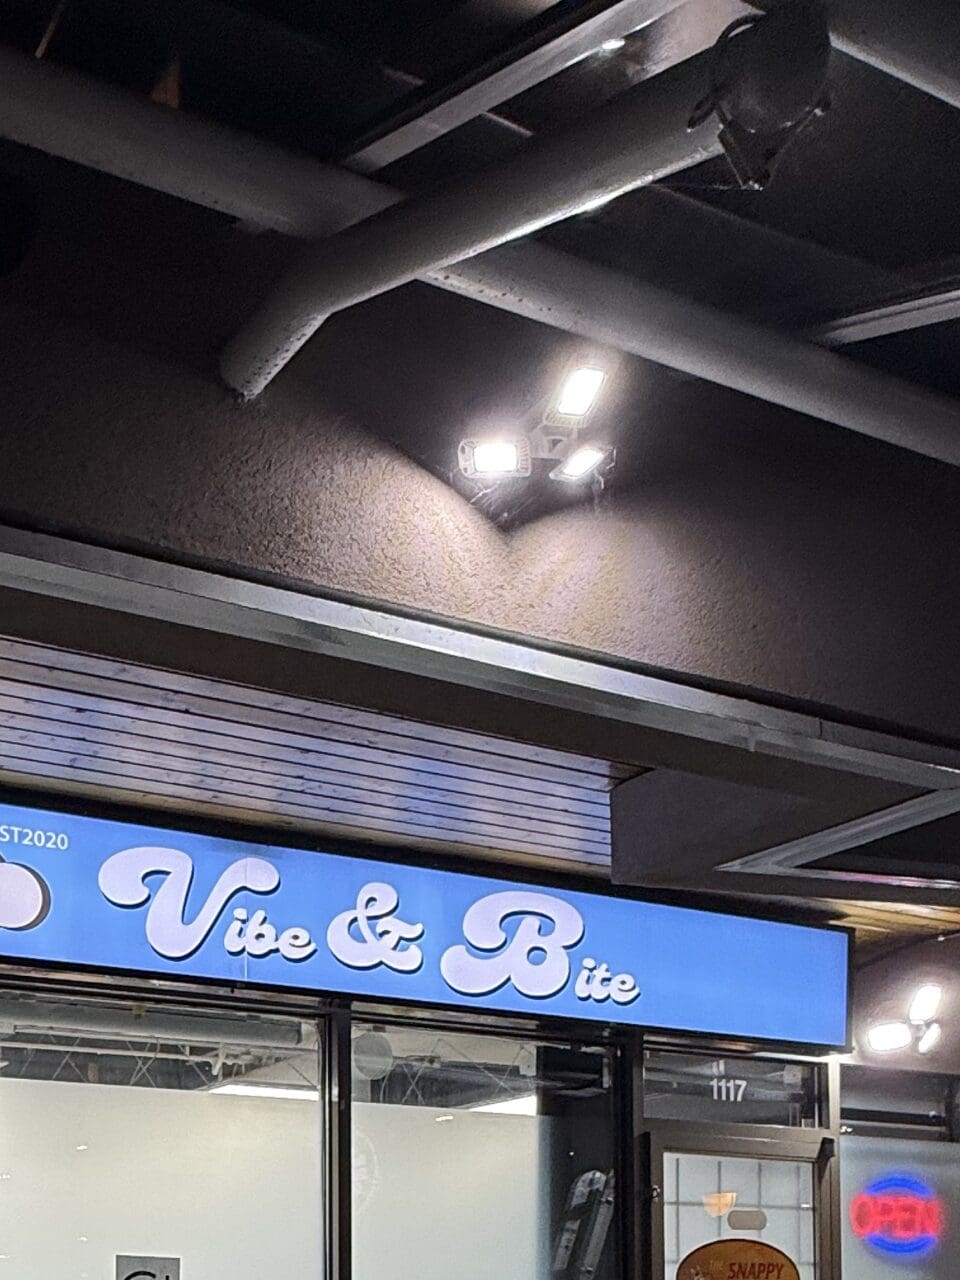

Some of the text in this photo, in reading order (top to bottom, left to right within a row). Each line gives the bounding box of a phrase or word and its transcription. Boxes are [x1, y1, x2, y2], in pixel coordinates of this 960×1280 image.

[98, 846, 641, 1004] Vibe & Bite
[709, 1078, 747, 1102] 1117
[727, 1262, 785, 1280] SNAPPY
